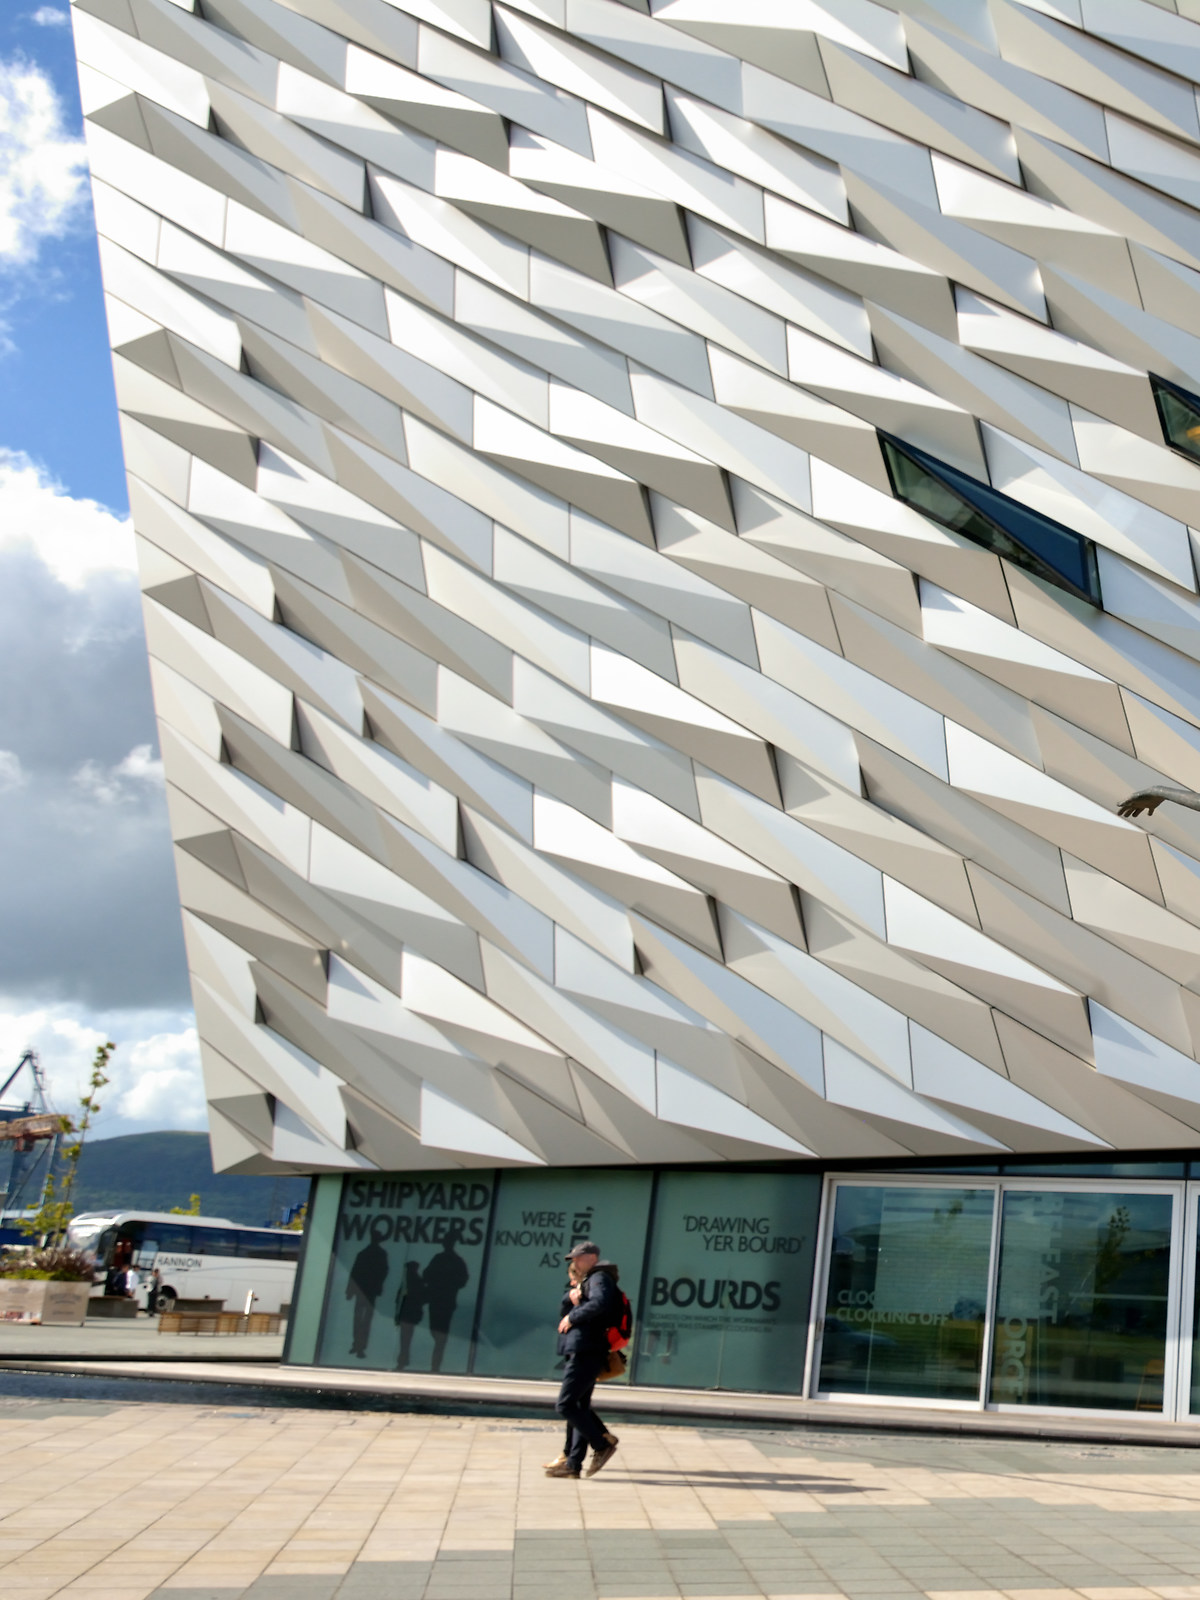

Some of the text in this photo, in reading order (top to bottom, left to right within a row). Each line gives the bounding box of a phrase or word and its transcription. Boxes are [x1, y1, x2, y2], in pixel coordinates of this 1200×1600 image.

[350, 1180, 490, 1211] SHIPYARD
[522, 1211, 567, 1228] WERE
[341, 1213, 485, 1246] WORKERS
[494, 1230, 564, 1247] KNOWN
[703, 1235, 734, 1252] YER
[157, 1256, 203, 1268] HANNON
[539, 1251, 561, 1268] AS
[651, 1277, 782, 1312] BOURDS
[836, 1307, 949, 1326] CLOCKING OFF
